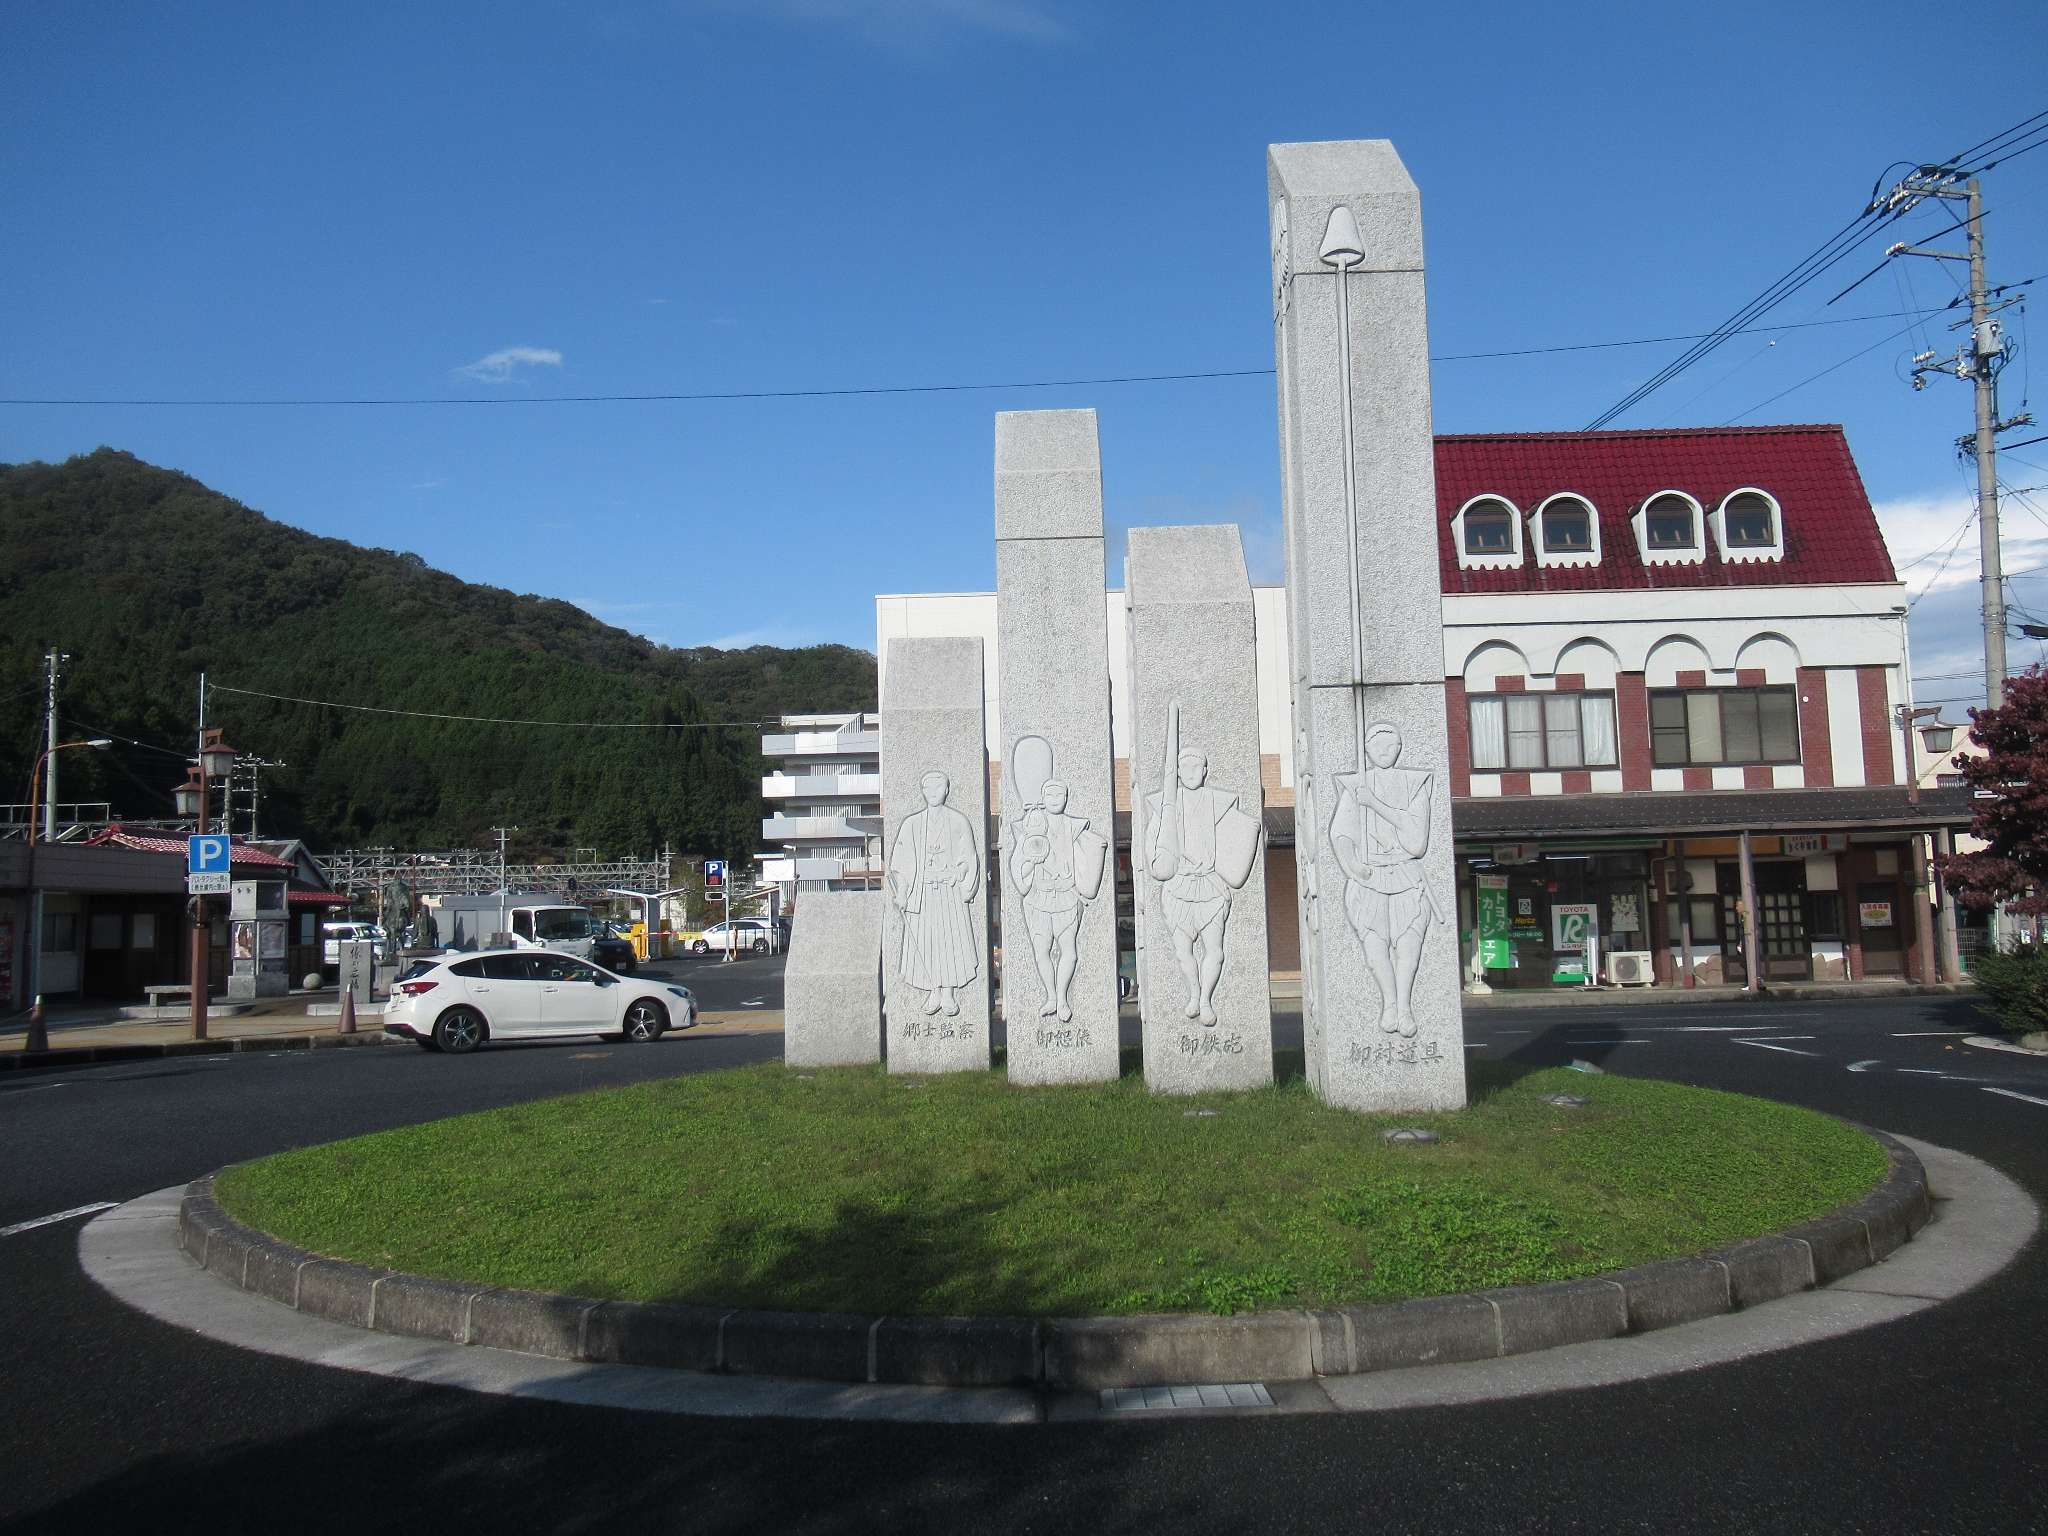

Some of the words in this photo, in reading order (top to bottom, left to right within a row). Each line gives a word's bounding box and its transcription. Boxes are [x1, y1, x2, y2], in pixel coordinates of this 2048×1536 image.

[200, 839, 222, 869] P
[709, 863, 719, 874] P
[1496, 892, 1505, 931] トヨタ
[1482, 897, 1496, 965] カーシェア
